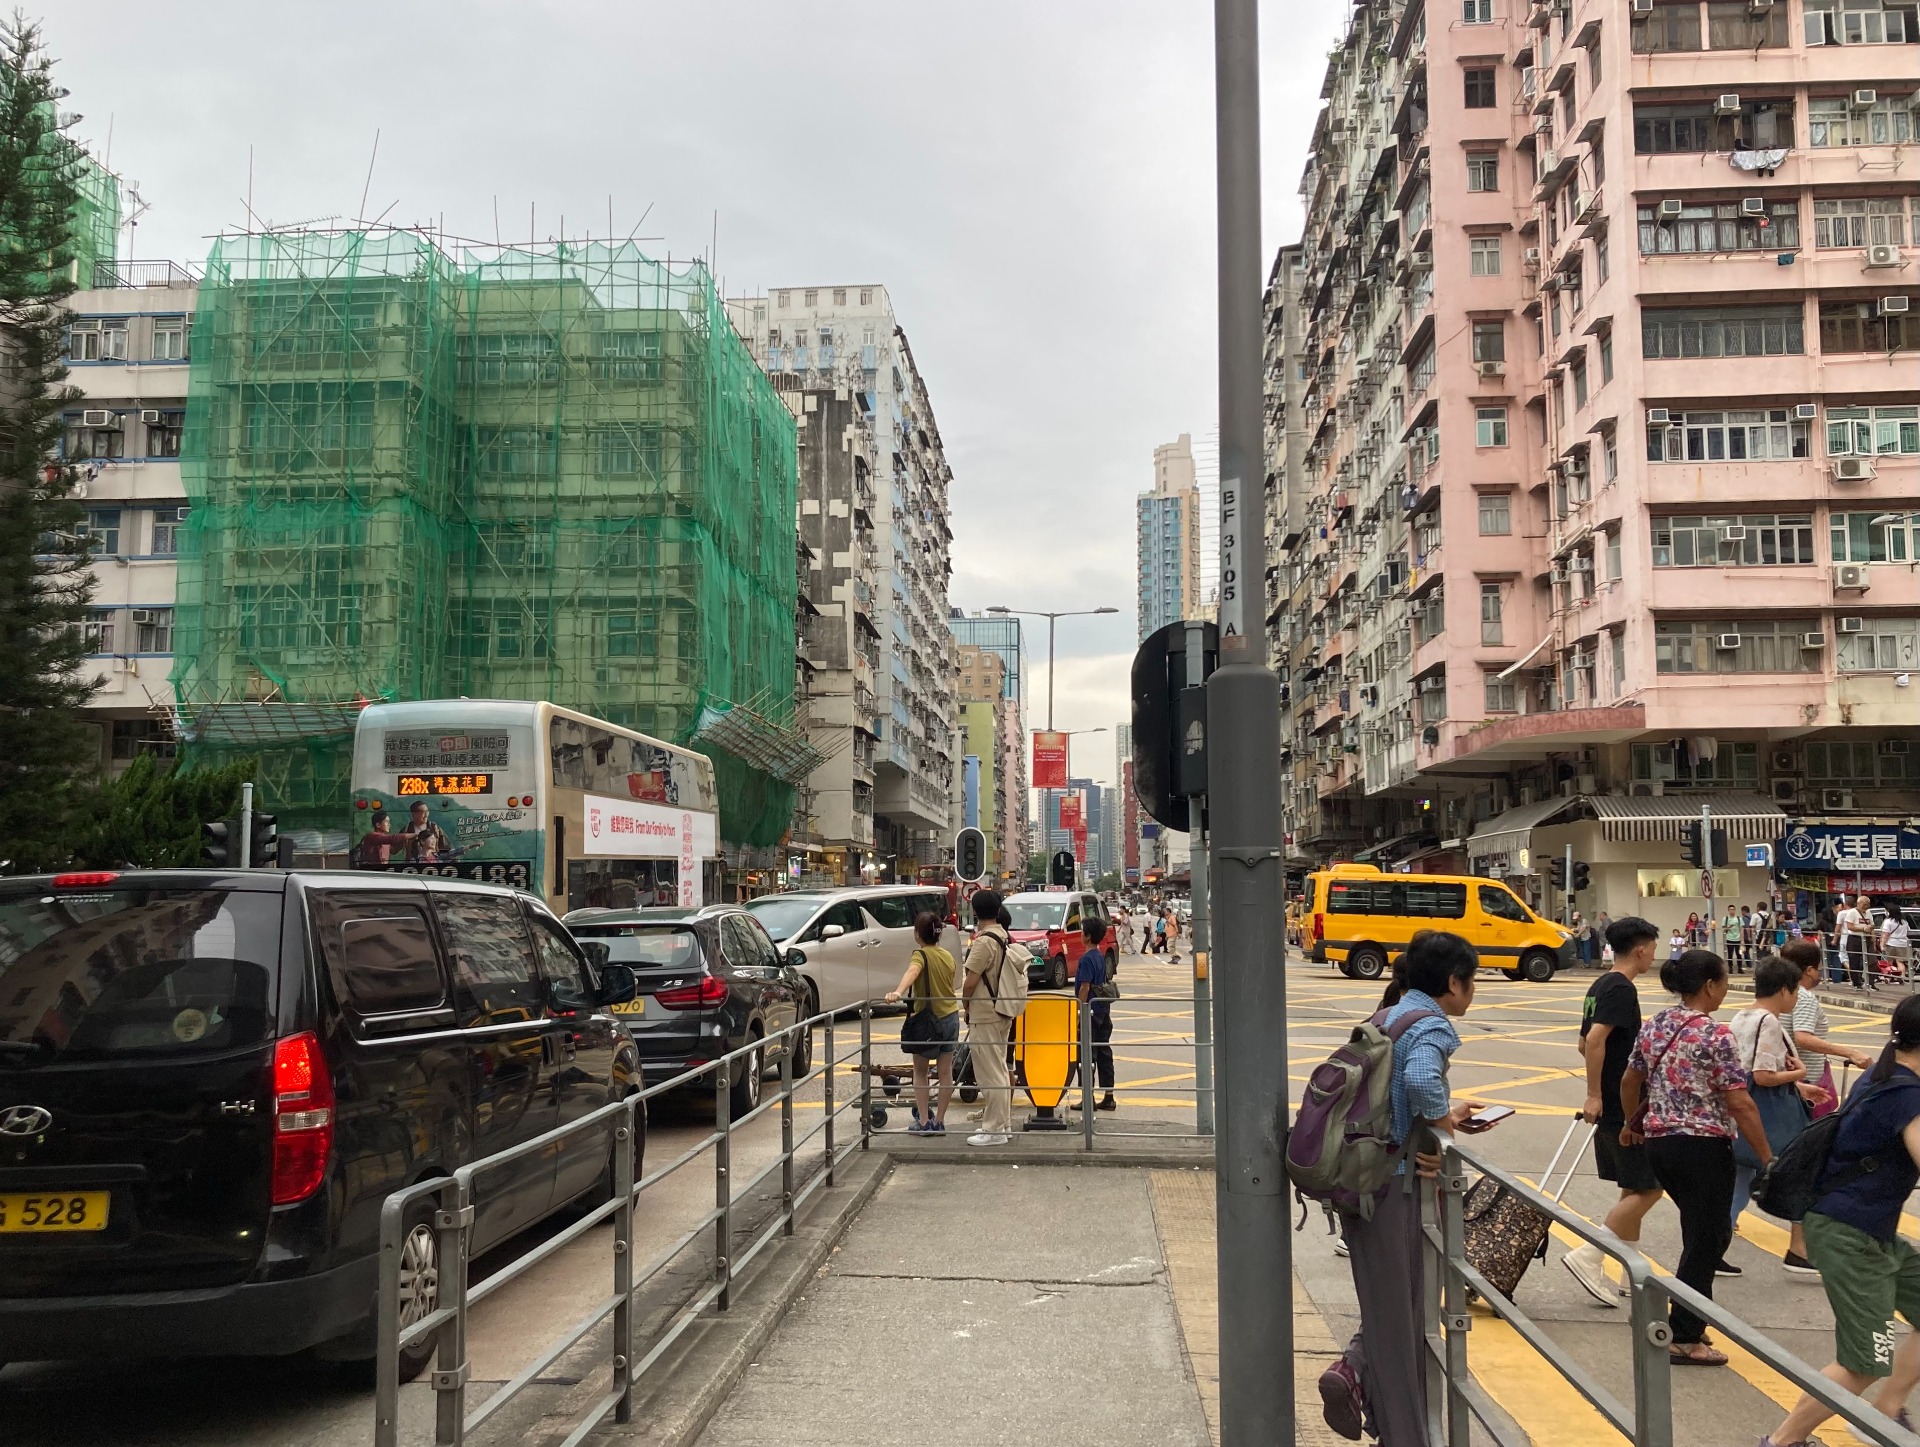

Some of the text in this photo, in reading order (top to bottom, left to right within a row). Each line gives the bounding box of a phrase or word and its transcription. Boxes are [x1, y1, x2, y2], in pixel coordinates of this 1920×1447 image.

[1223, 534, 1236, 601] 3105
[1225, 622, 1237, 636] A
[1815, 833, 1898, 860] 水手屋
[662, 979, 684, 987] X5
[21, 1197, 87, 1226] 528
[1872, 1331, 1889, 1366] BSX
